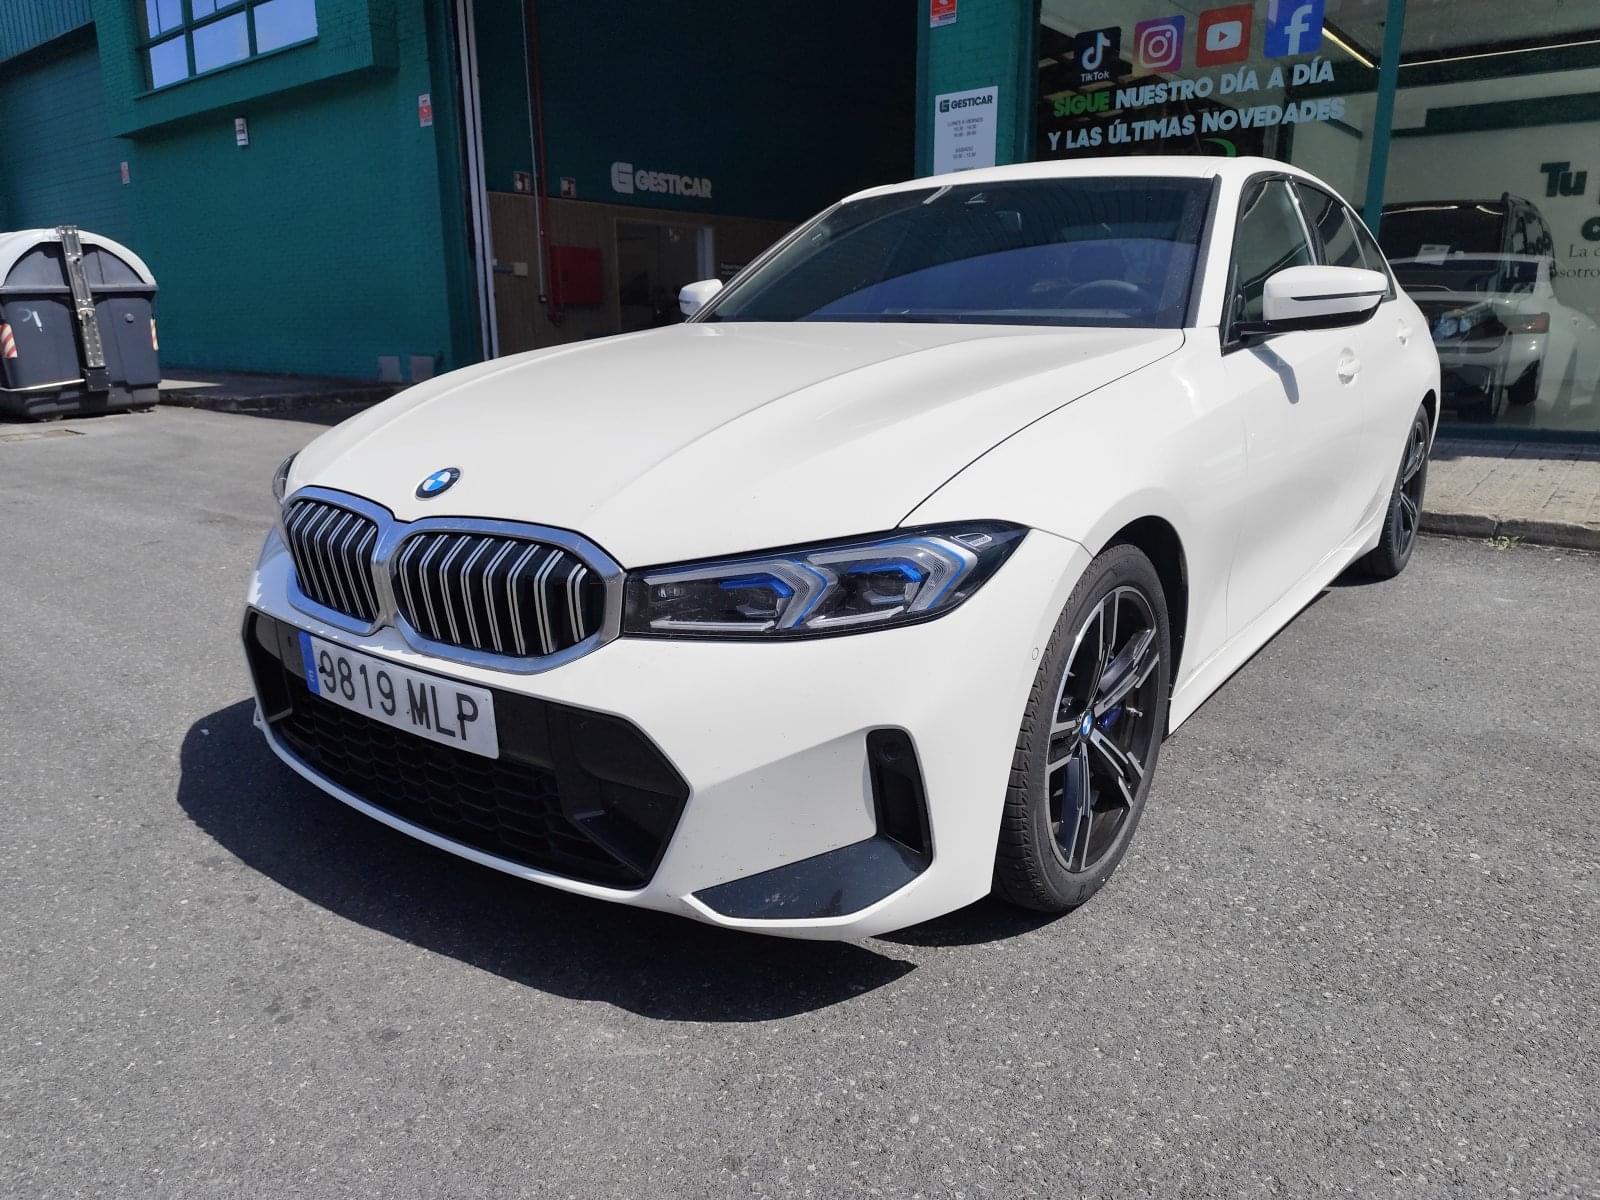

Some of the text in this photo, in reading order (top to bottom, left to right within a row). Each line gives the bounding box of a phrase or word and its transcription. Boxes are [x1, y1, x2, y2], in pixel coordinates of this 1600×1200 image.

[1053, 55, 1335, 117] SIGUE NUESTRO DÍA A DÍA
[1080, 71, 1110, 82] TikTok
[951, 95, 993, 109] GESTICAR
[1048, 97, 1346, 151] Y LAS ÚLTIMAS NOVEDADES
[635, 170, 713, 198] GESTICAR
[1540, 161, 1588, 198] Tu
[1569, 244, 1587, 258] La
[318, 650, 479, 741] 9819 MLP
